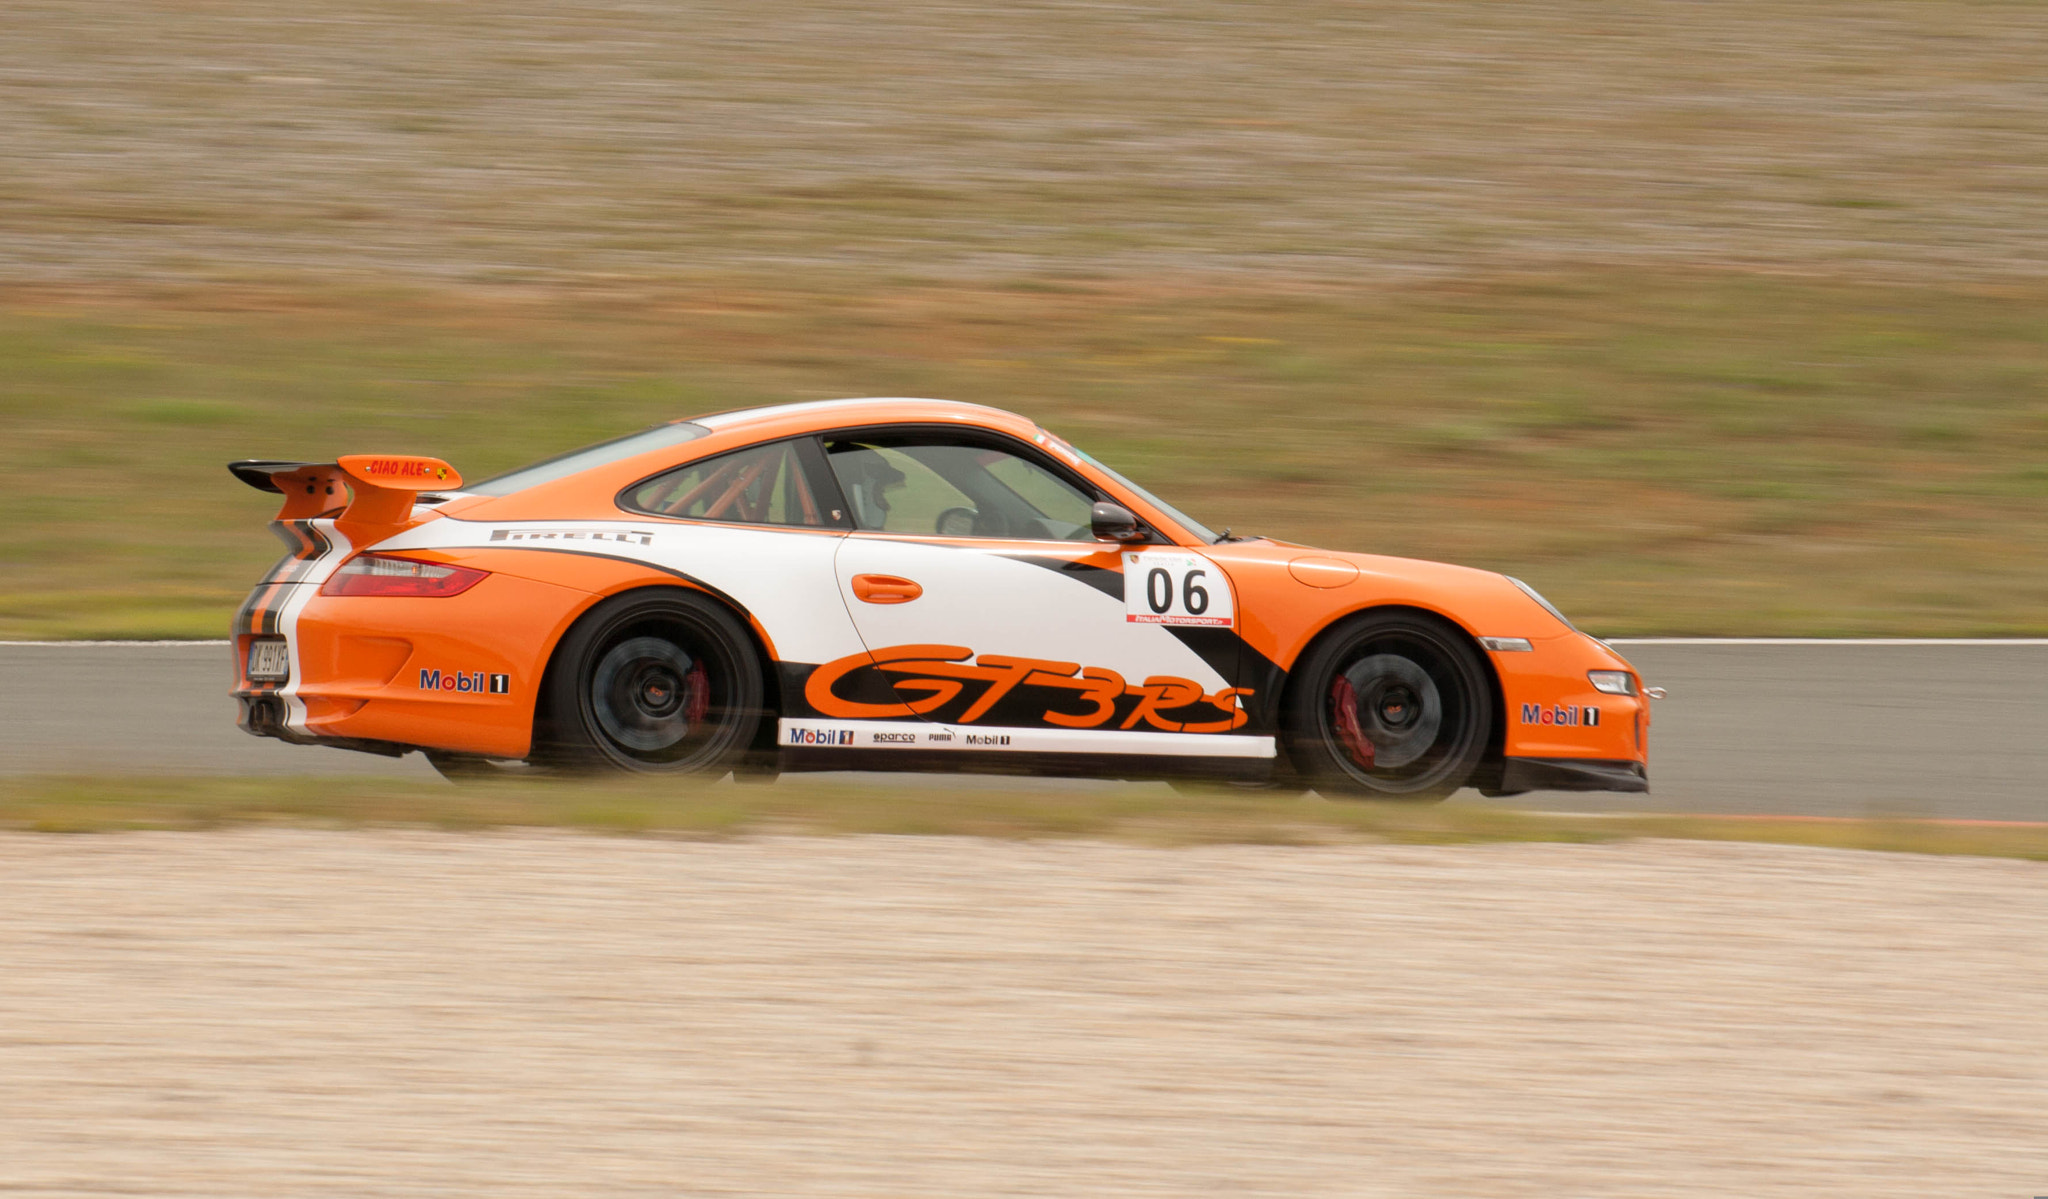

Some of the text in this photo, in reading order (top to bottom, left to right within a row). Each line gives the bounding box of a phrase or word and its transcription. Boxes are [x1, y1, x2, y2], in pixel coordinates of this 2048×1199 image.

[370, 460, 424, 476] CIAO ALE
[489, 528, 654, 546] PIRELLI
[1146, 567, 1209, 615] 06
[419, 668, 484, 693] Mobil
[1521, 703, 1579, 726] Mobil
[790, 728, 836, 745] Mobil
[928, 733, 953, 742] PUMA
[965, 735, 998, 745] Mobil
